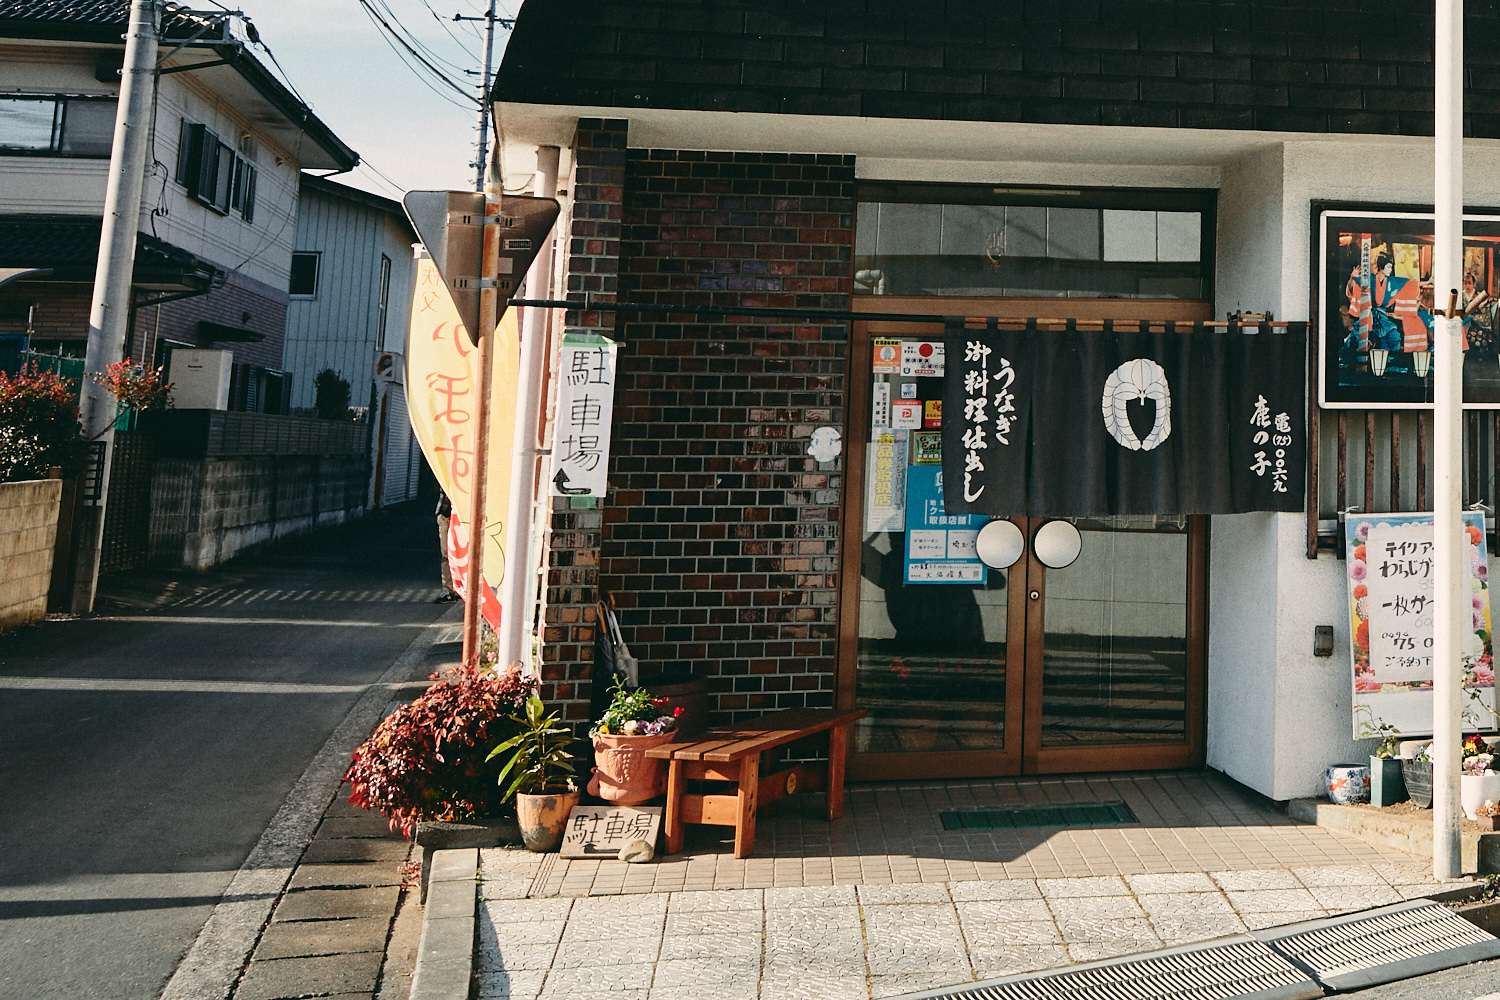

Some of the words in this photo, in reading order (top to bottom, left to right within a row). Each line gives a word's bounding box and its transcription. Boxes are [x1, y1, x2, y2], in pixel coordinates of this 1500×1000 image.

[561, 347, 610, 471] 駐車場
[962, 341, 992, 503] 御料理仕出し
[993, 357, 1018, 446] うなぎ
[1250, 394, 1272, 476] 鹿の子
[1385, 541, 1434, 558] テイクア
[567, 812, 653, 844] 駐車場
